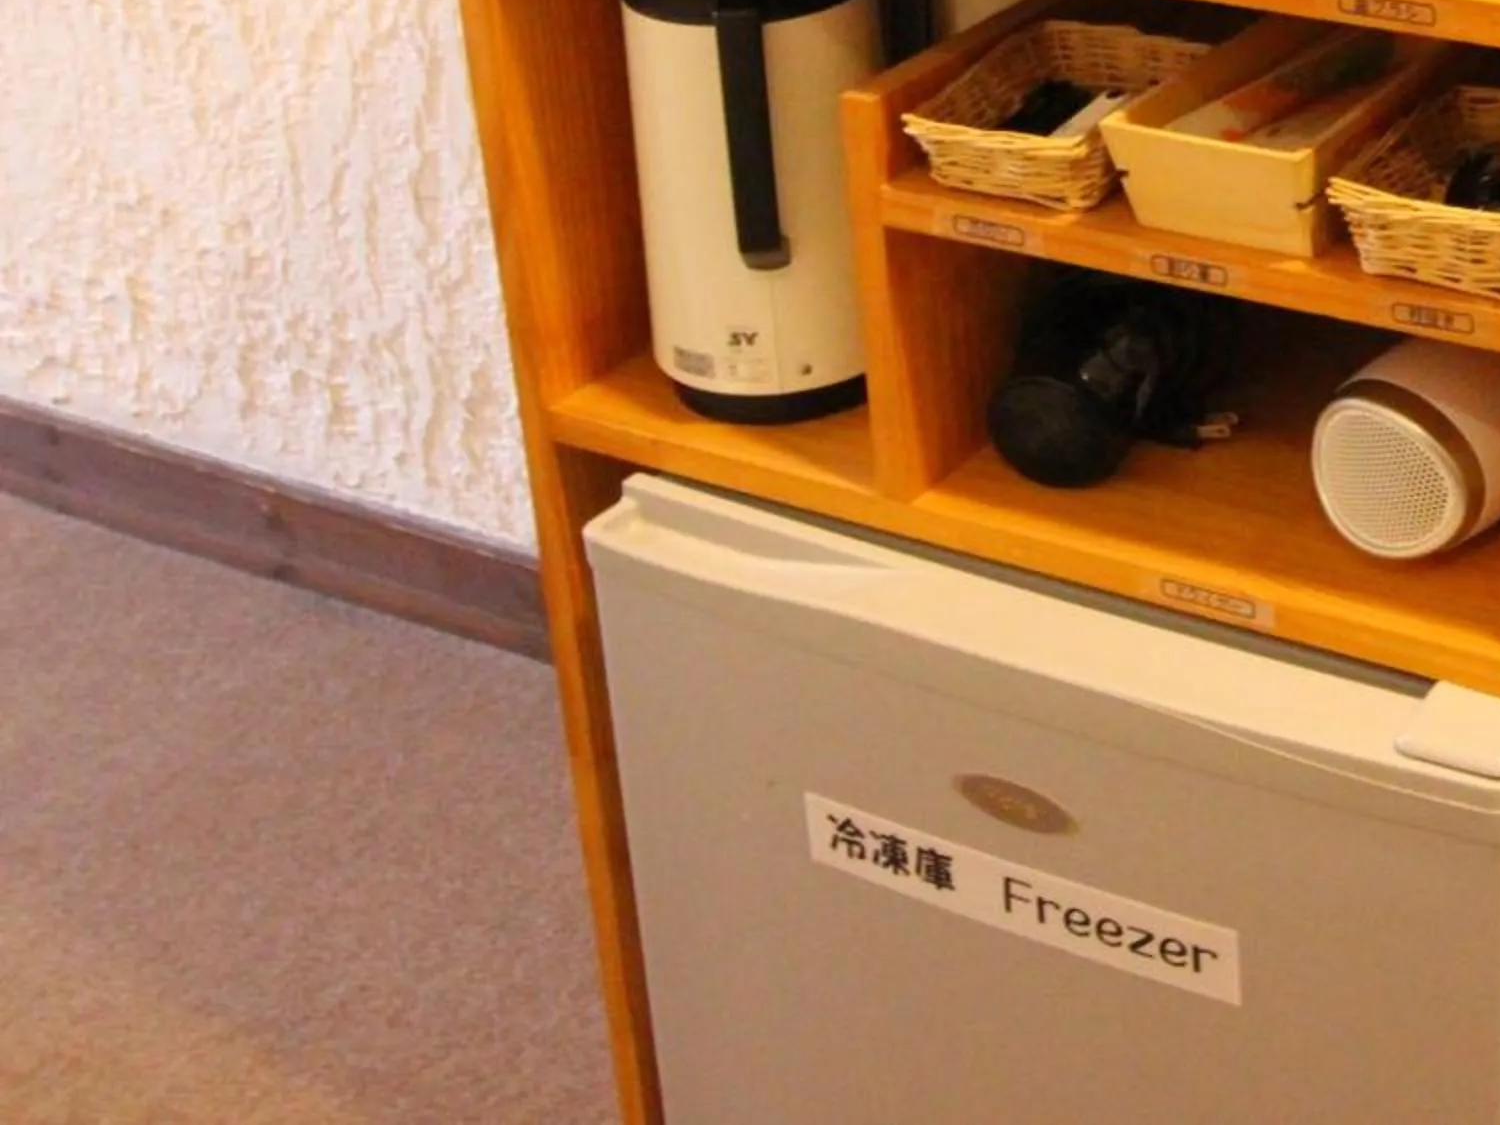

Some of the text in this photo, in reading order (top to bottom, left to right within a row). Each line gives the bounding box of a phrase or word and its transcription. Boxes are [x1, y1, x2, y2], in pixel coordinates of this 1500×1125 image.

[826, 814, 1218, 974] 冷凍庫 Freezer
